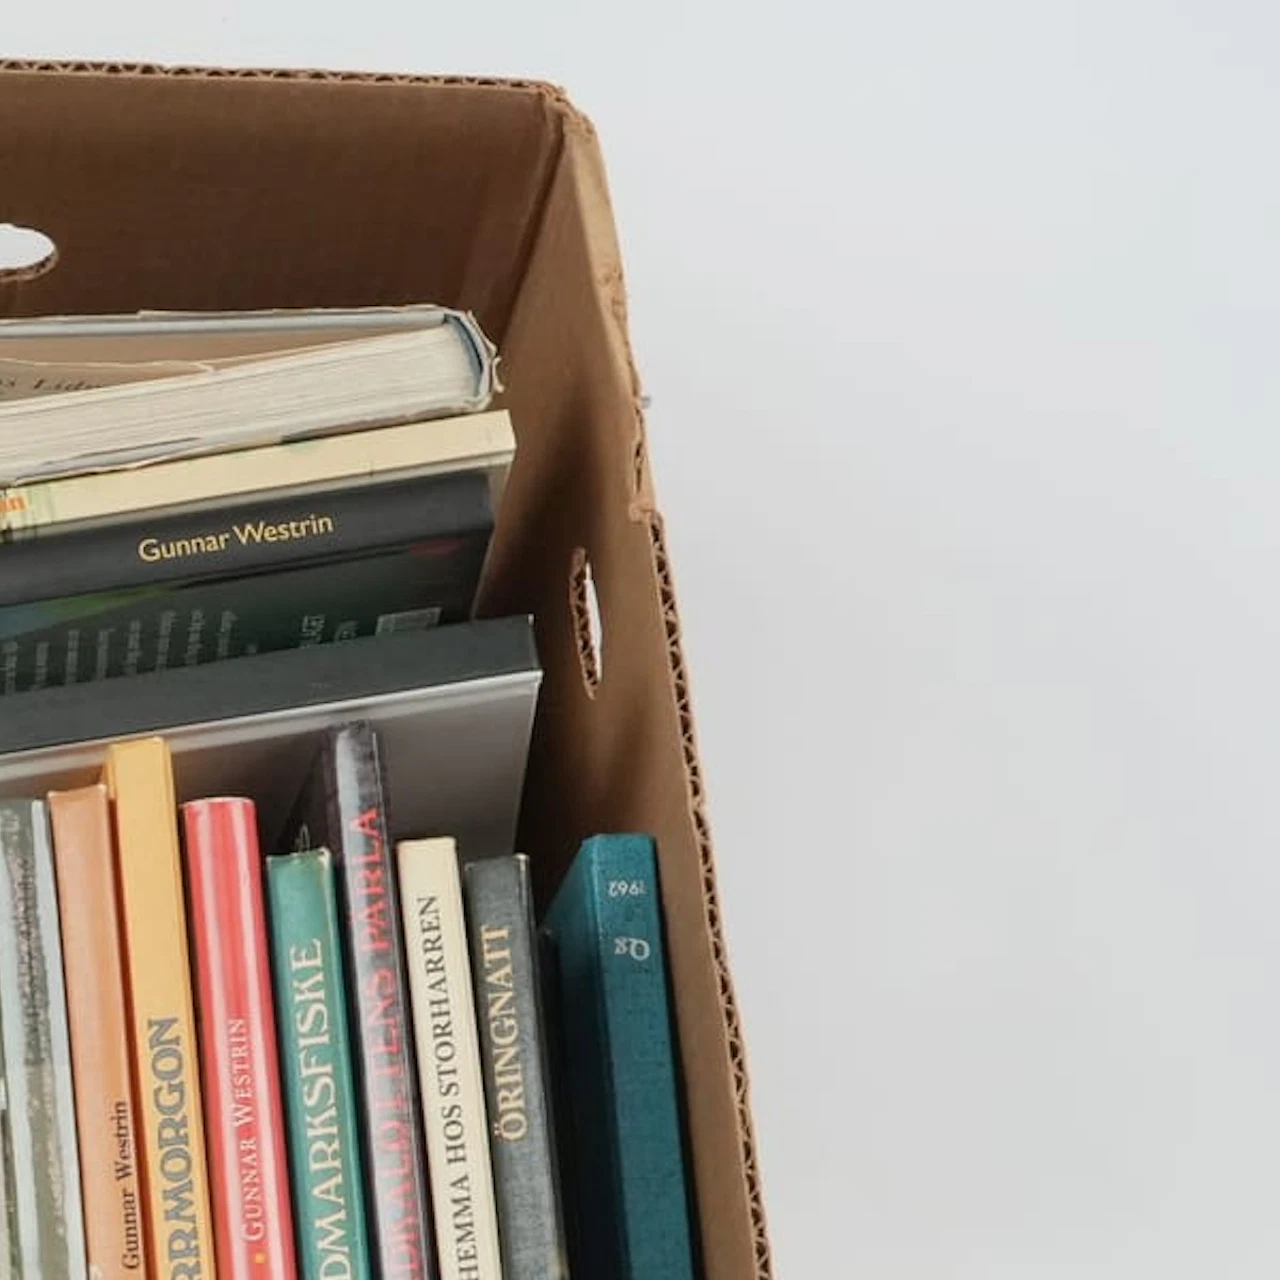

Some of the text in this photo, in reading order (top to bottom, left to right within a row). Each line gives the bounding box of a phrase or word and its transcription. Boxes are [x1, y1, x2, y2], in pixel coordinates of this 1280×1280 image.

[138, 532, 230, 563] Gunnar
[234, 513, 334, 548] Westrin
[347, 807, 393, 952] PÄRLA
[614, 937, 651, 959] Qg
[415, 894, 463, 1098] STORHARREN
[479, 924, 528, 1141] ÖRINGNATT
[226, 1017, 257, 1129] WESTRIN
[109, 1100, 134, 1181] Westrin
[439, 1104, 468, 1165] HOS
[116, 1188, 141, 1271] Gunnar
[239, 1134, 266, 1241] GUNNAR
